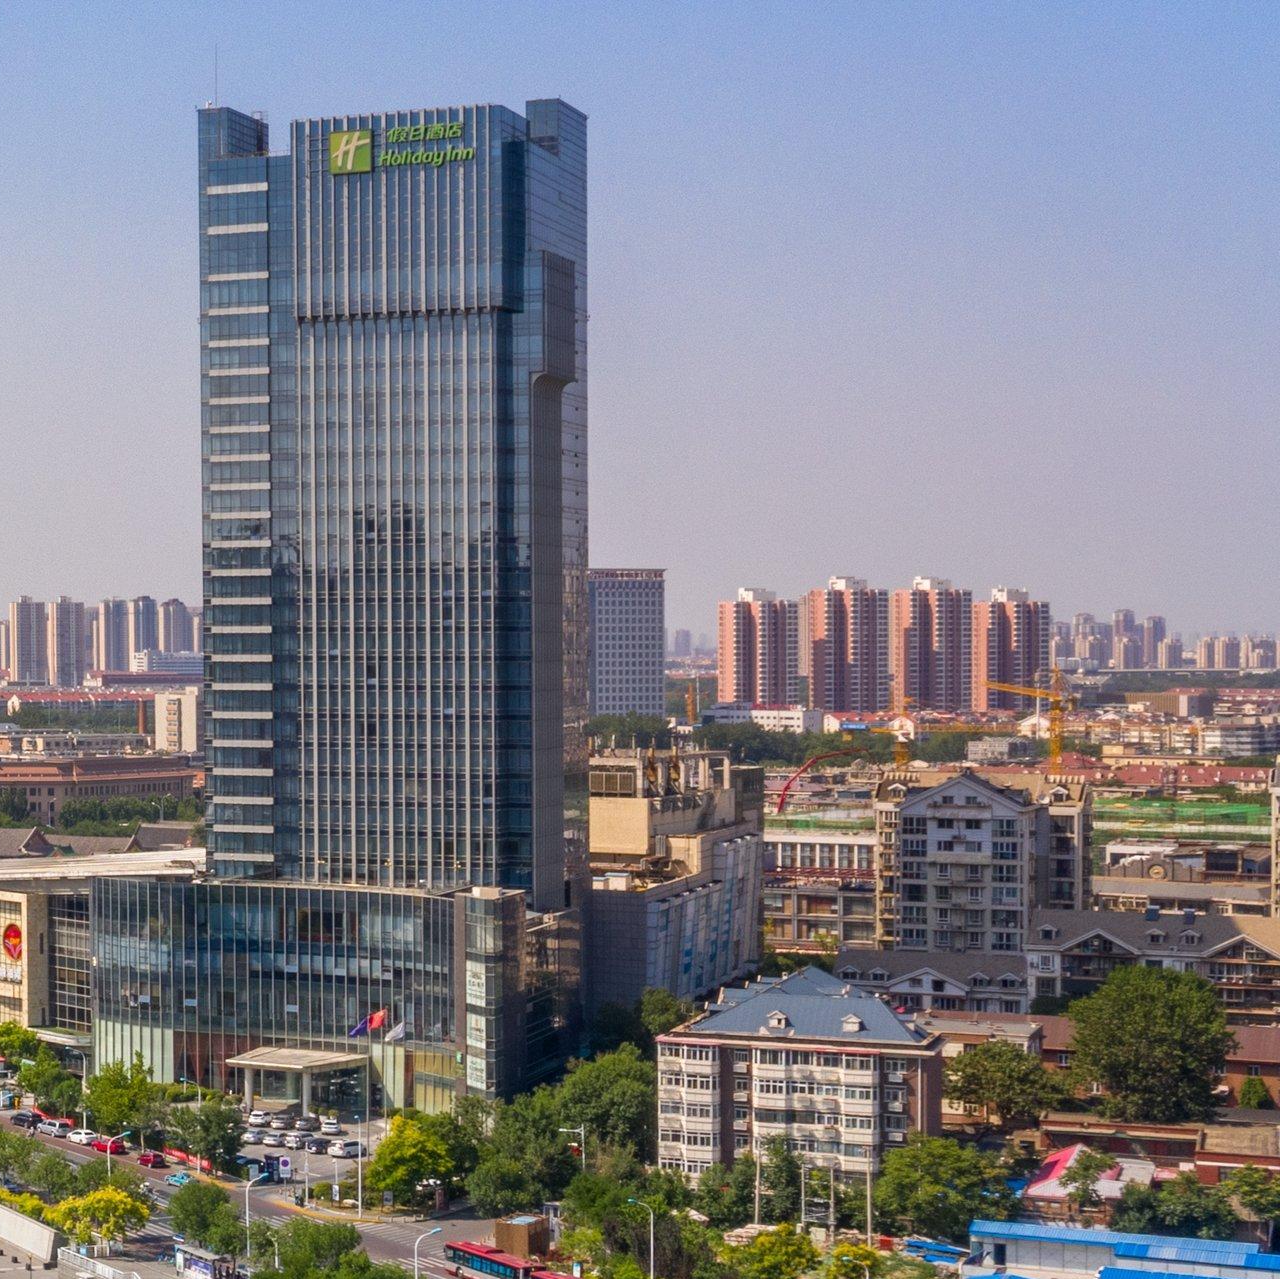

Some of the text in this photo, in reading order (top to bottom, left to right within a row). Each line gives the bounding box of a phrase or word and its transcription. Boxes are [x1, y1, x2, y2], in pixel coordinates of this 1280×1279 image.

[387, 123, 461, 142] 假日酒店
[379, 145, 475, 167] Holiday Inn
